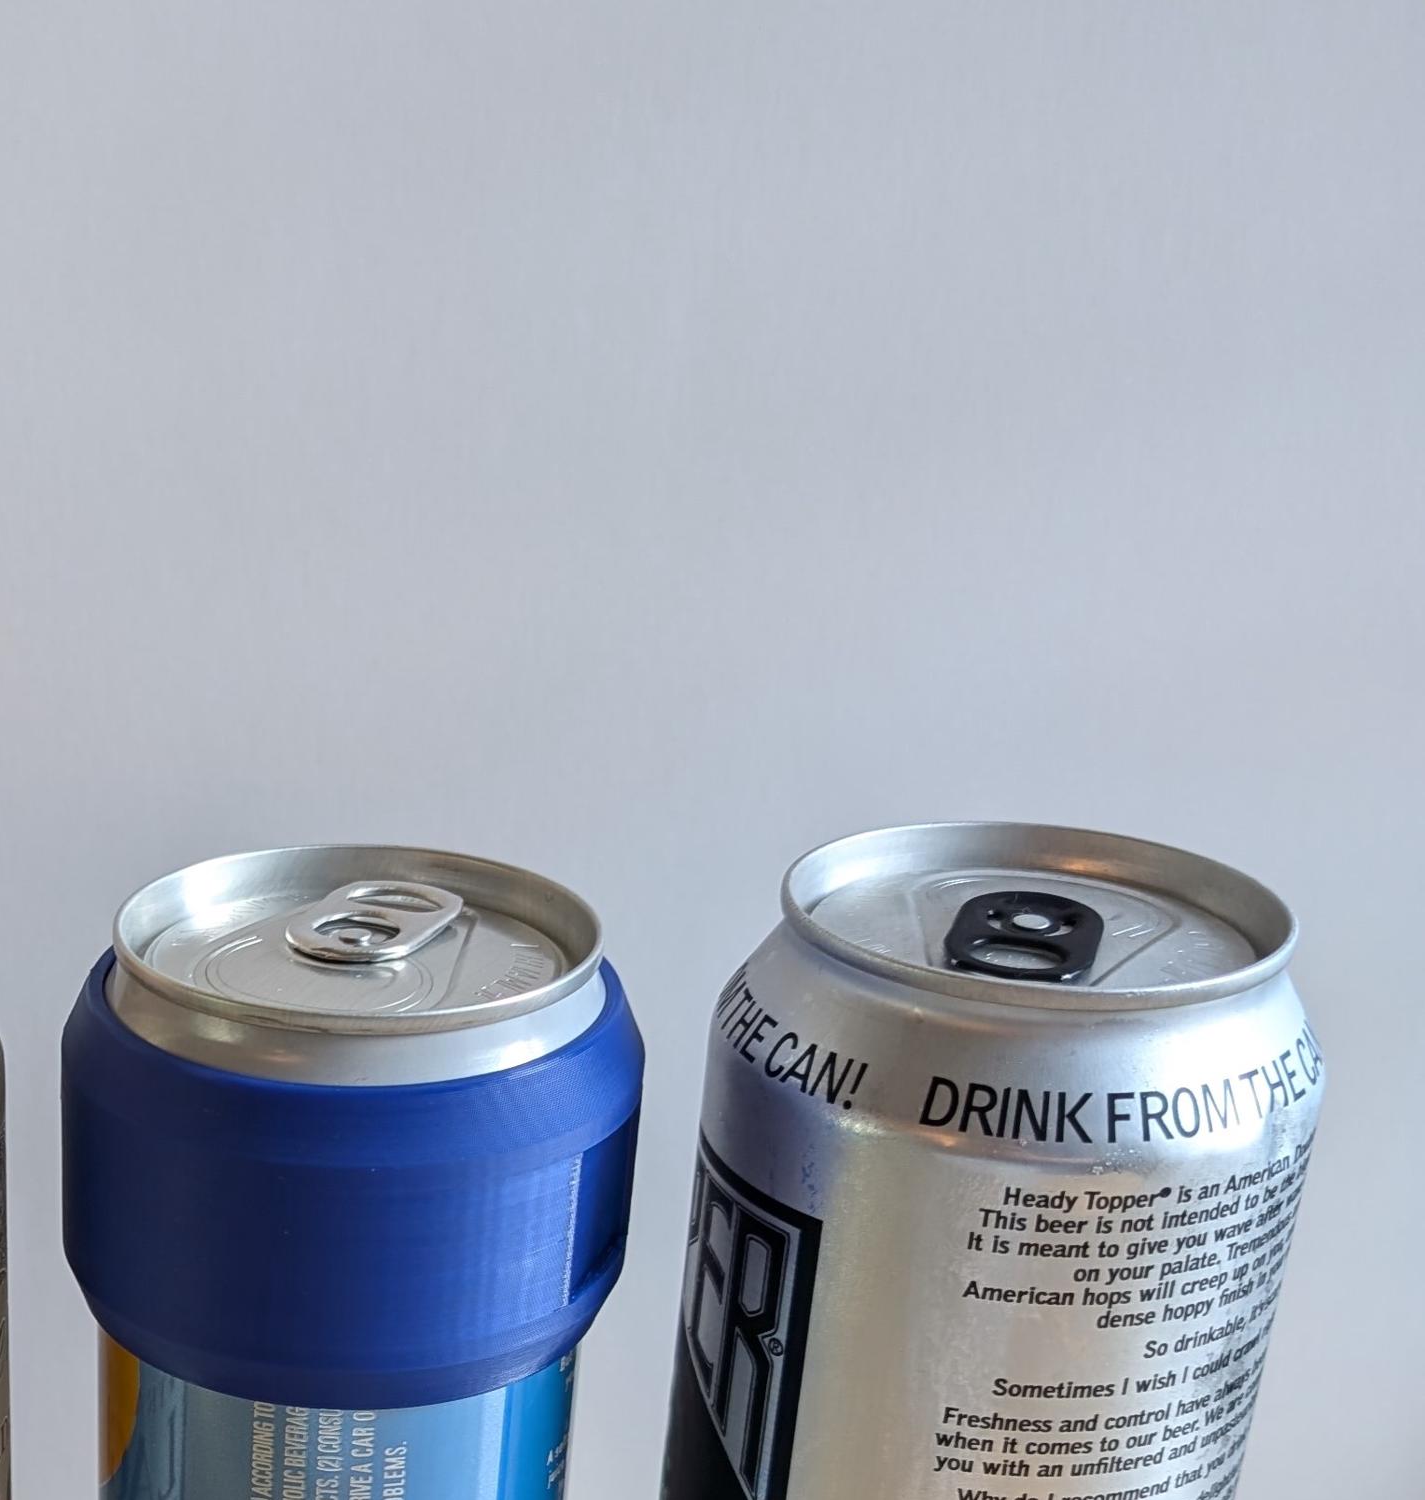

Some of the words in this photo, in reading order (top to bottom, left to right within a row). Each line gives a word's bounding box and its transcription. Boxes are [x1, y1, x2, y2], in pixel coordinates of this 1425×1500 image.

[721, 988, 778, 1063] THE
[764, 1031, 868, 1110] CAN!
[919, 1076, 1093, 1144] DRINK
[1106, 1078, 1241, 1143] FROM
[1238, 1049, 1306, 1119] THE
[1003, 1187, 1078, 1213] Heady
[1224, 1155, 1290, 1195] American
[979, 1208, 1027, 1230] This
[1035, 1214, 1088, 1234] beer
[1095, 1216, 1112, 1234] is
[1120, 1213, 1154, 1233] not
[1161, 1196, 1241, 1229] intended
[992, 1236, 1009, 1254] is
[1018, 1241, 1089, 1258] meant
[1098, 1241, 1119, 1258] to
[1127, 1236, 1168, 1259] give
[1173, 1231, 1207, 1255] you
[1214, 1219, 1252, 1242] wave
[962, 1280, 1075, 1306] American
[1082, 1287, 1131, 1308] hops
[1140, 1280, 1175, 1302] will
[1181, 1271, 1228, 1297] creep
[1073, 1268, 1099, 1282] on
[1105, 1263, 1154, 1286] your
[1160, 1252, 1221, 1280] palate.
[1097, 1311, 1156, 1329] dense
[1162, 1297, 1215, 1323] hoppy
[1218, 1278, 1254, 1308] finish
[1143, 1341, 1168, 1359] So
[1174, 1316, 1247, 1353] drinkable,
[992, 1378, 1115, 1399] Sometimes
[1136, 1370, 1177, 1393] wish
[1192, 1349, 1232, 1380] could
[942, 1406, 1053, 1433] Freshness
[1058, 1414, 1099, 1433] and
[1104, 1403, 1171, 1430] control
[1175, 1394, 1214, 1417] have
[933, 1455, 974, 1472] you
[982, 1459, 1030, 1477] with
[1036, 1464, 1063, 1477] an
[1070, 1451, 1164, 1476] unfiltered
[1168, 1436, 1197, 1460] and
[935, 1431, 993, 1453] when
[1025, 1441, 1093, 1455] comes
[1126, 1431, 1158, 1449] our
[1162, 1418, 1199, 1442] beer.
[251, 1422, 274, 1496] ACCORDING
[1174, 1464, 1203, 1488] that
